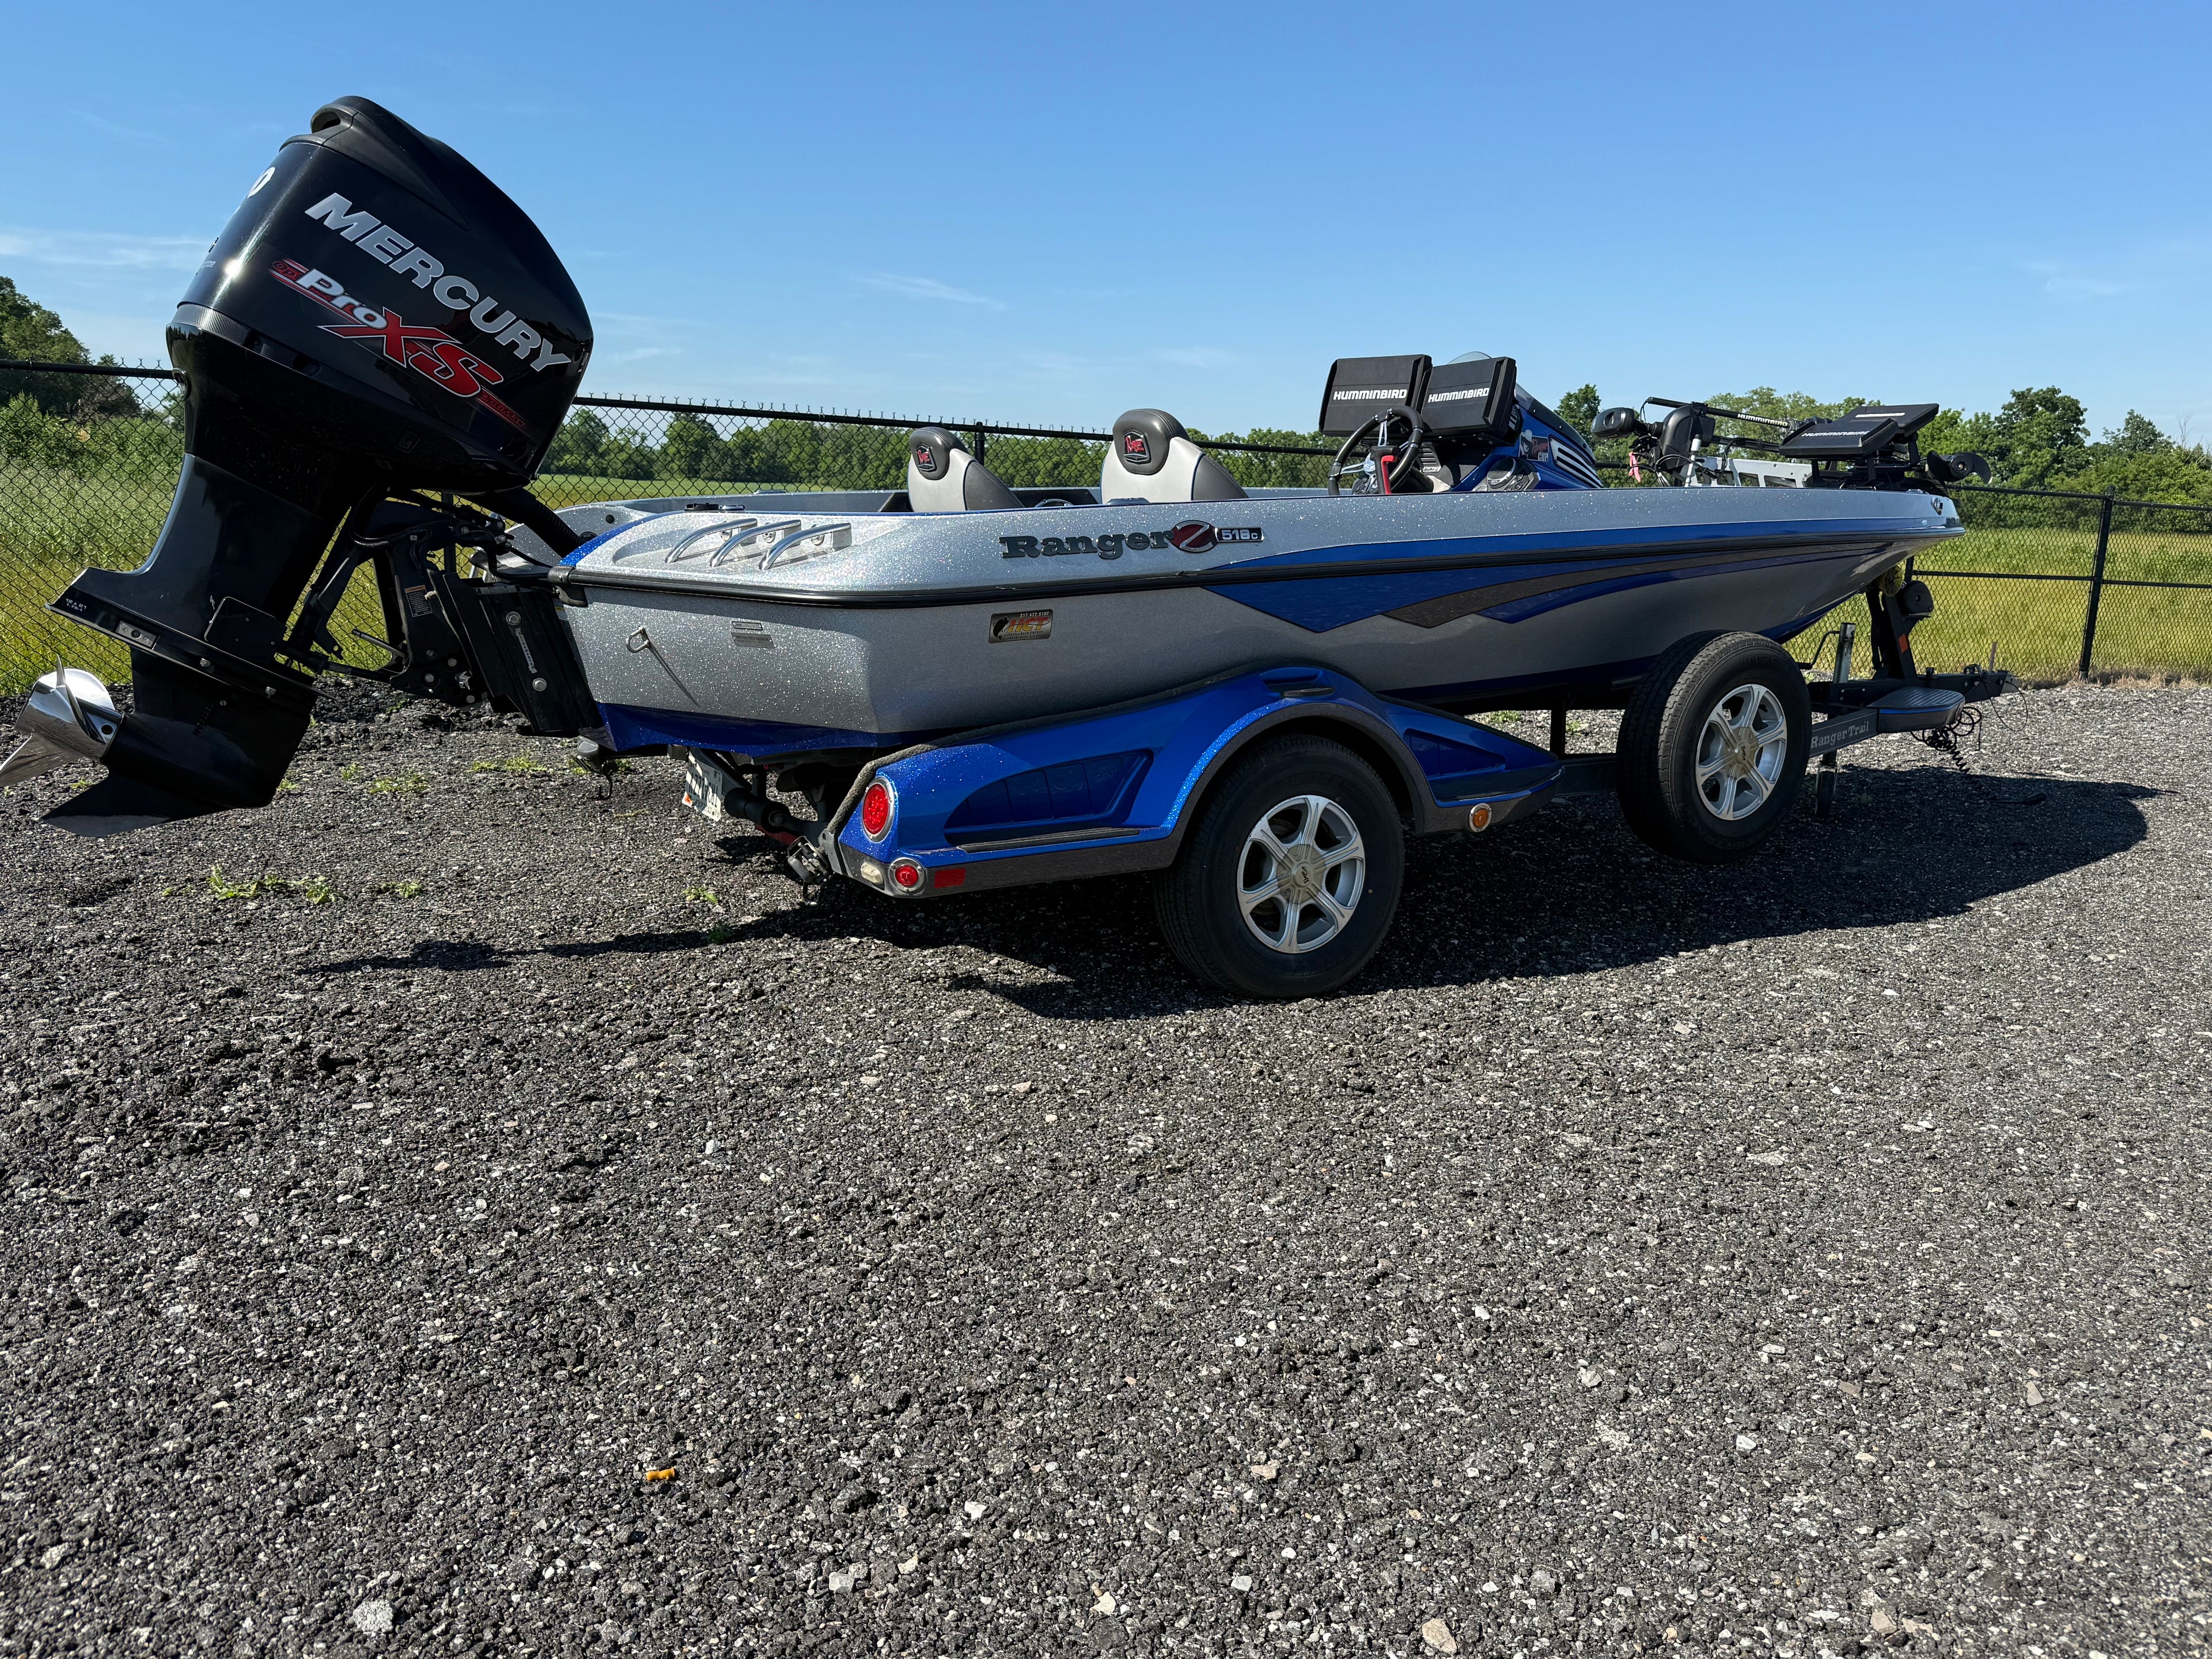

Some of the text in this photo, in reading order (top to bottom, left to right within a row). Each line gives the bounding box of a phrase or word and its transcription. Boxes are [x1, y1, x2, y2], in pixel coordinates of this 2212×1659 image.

[305, 192, 571, 372] MERCURY
[295, 268, 388, 329] Pro
[316, 305, 505, 397] XS
[1333, 389, 1407, 400] HUMMINBIRD
[1427, 387, 1490, 403] HUMMINBIRD
[1737, 413, 1789, 427] HUMMINBIRD
[998, 529, 1175, 560] Ranger
[1221, 529, 1258, 540] 518c
[1810, 721, 1869, 749] Ranger Trail
